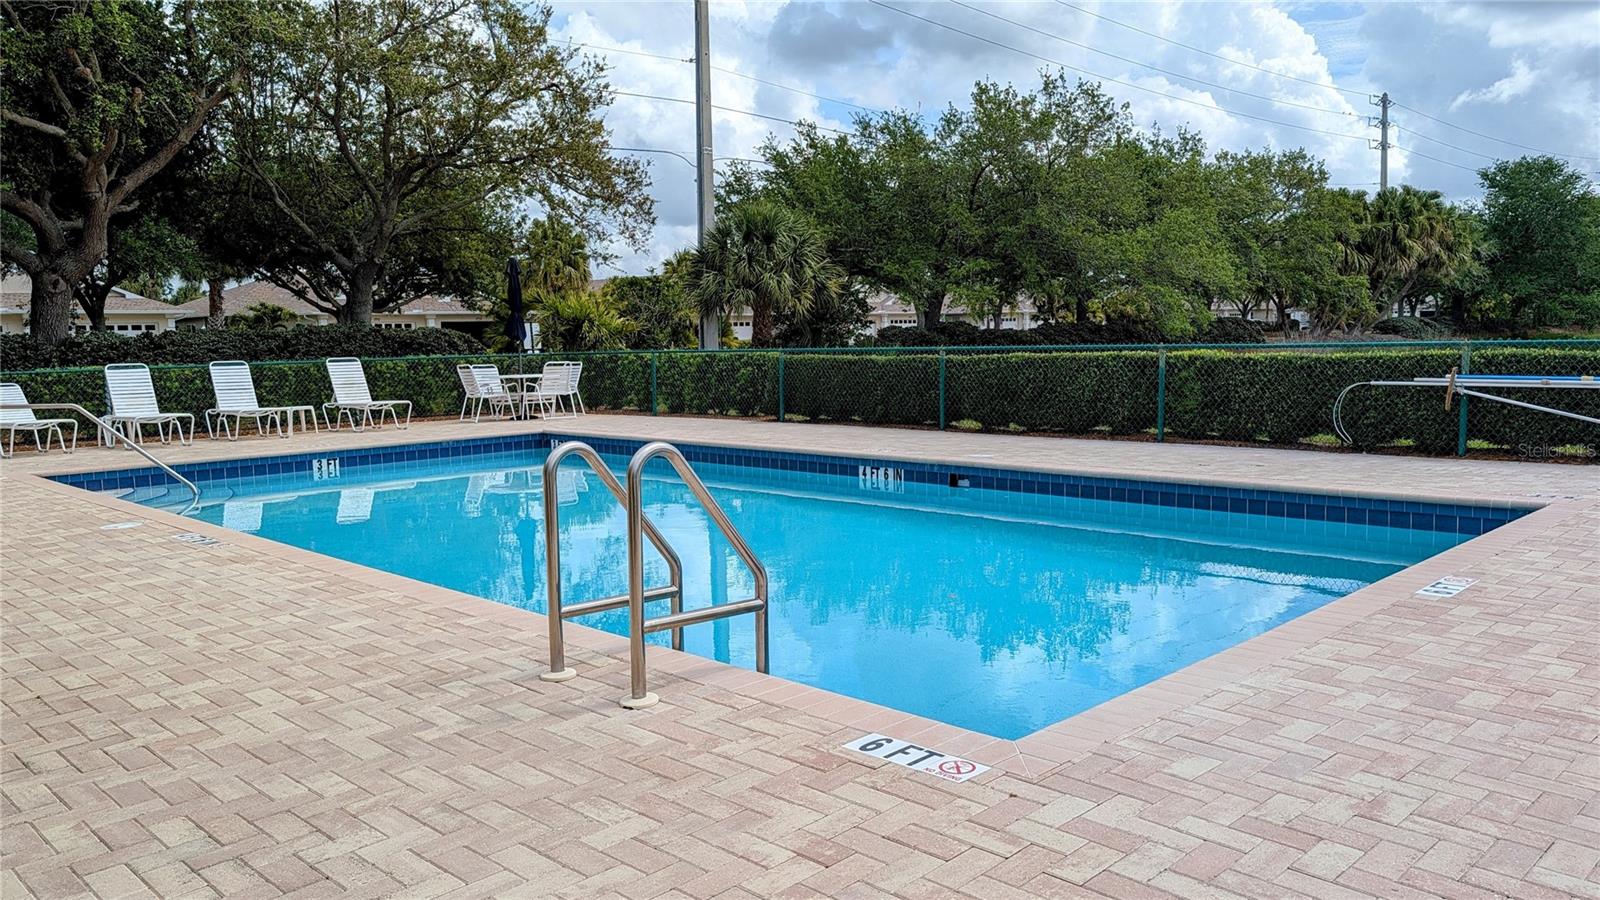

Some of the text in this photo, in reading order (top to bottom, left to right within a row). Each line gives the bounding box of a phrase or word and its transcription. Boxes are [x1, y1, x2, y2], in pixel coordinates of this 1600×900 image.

[316, 458, 338, 470] 3 FT
[870, 466, 881, 480] FT
[883, 468, 889, 481] 6
[893, 468, 903, 482] IN
[858, 737, 945, 767] 6 FT
